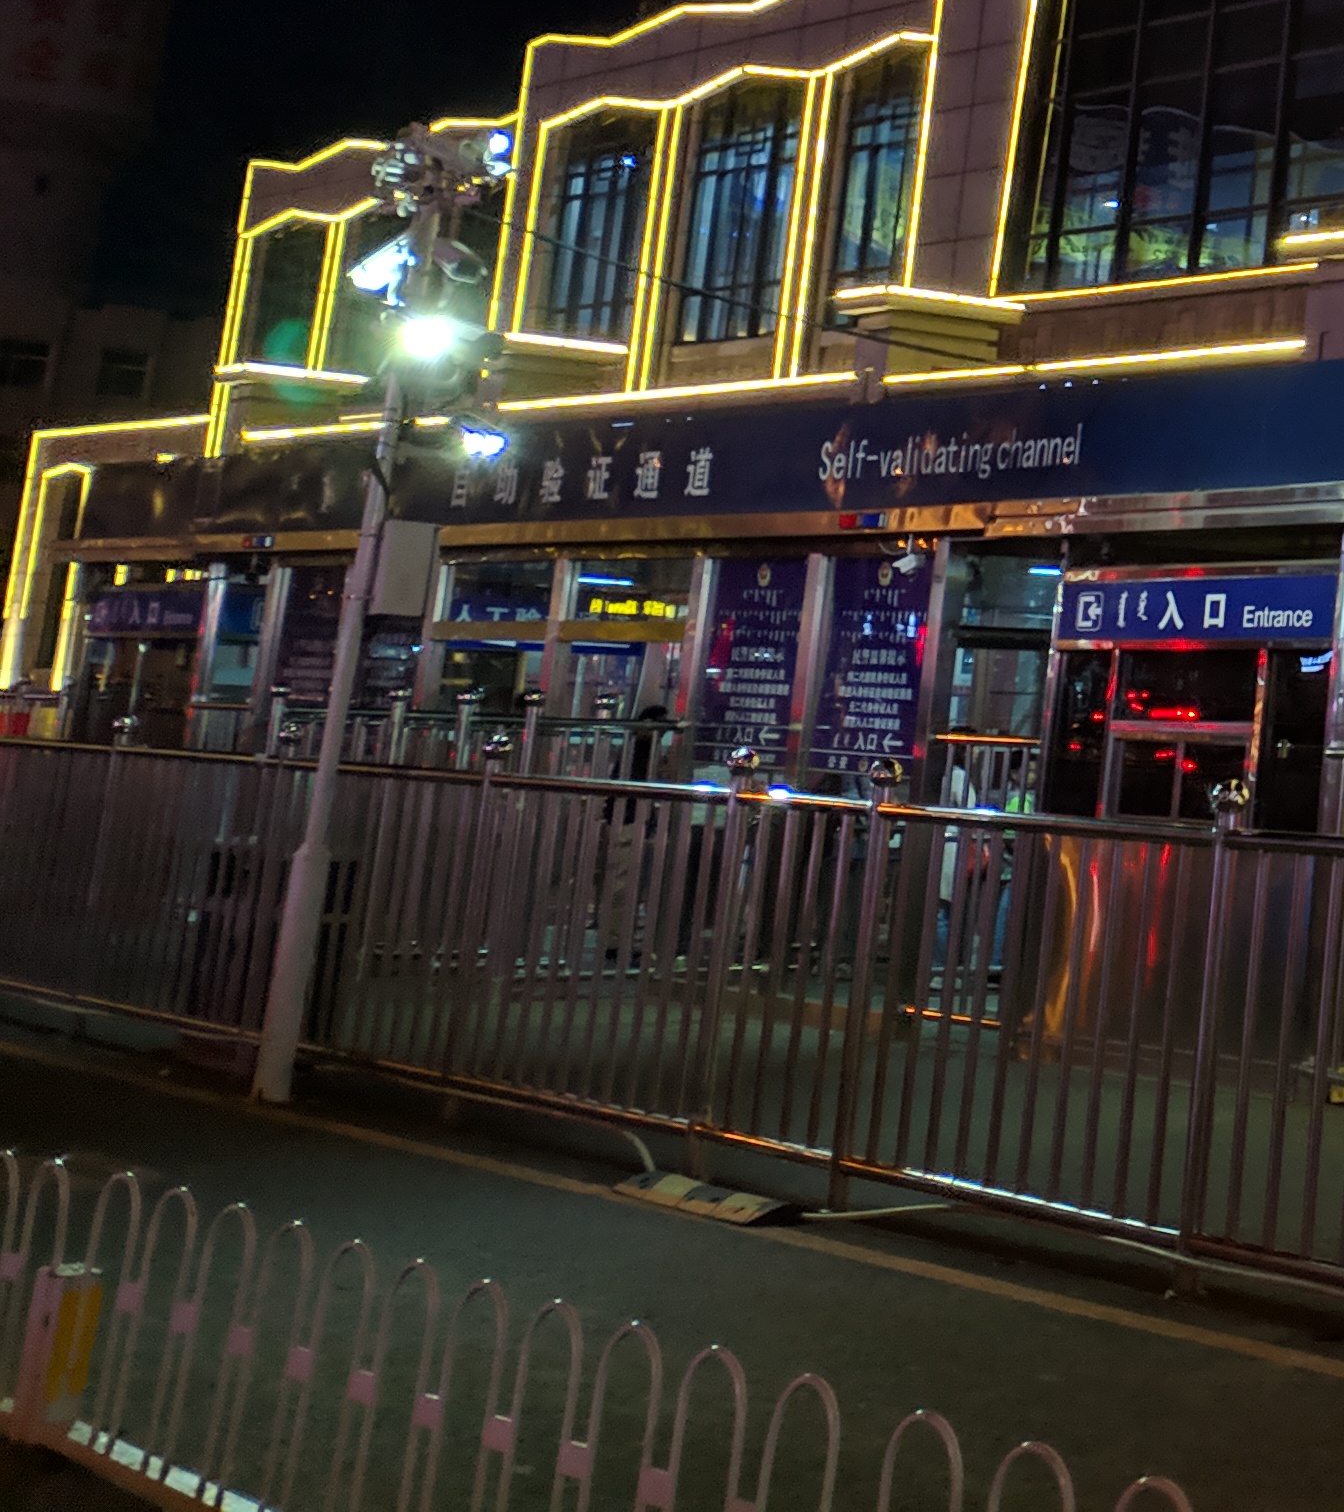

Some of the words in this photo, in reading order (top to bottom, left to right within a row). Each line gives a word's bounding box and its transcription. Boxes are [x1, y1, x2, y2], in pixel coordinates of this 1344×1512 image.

[449, 447, 715, 508] 自助验证通道
[818, 432, 992, 482] Self-validating
[996, 423, 1083, 470] channel
[1157, 590, 1227, 630] 入口
[1242, 605, 1313, 628] Entrance
